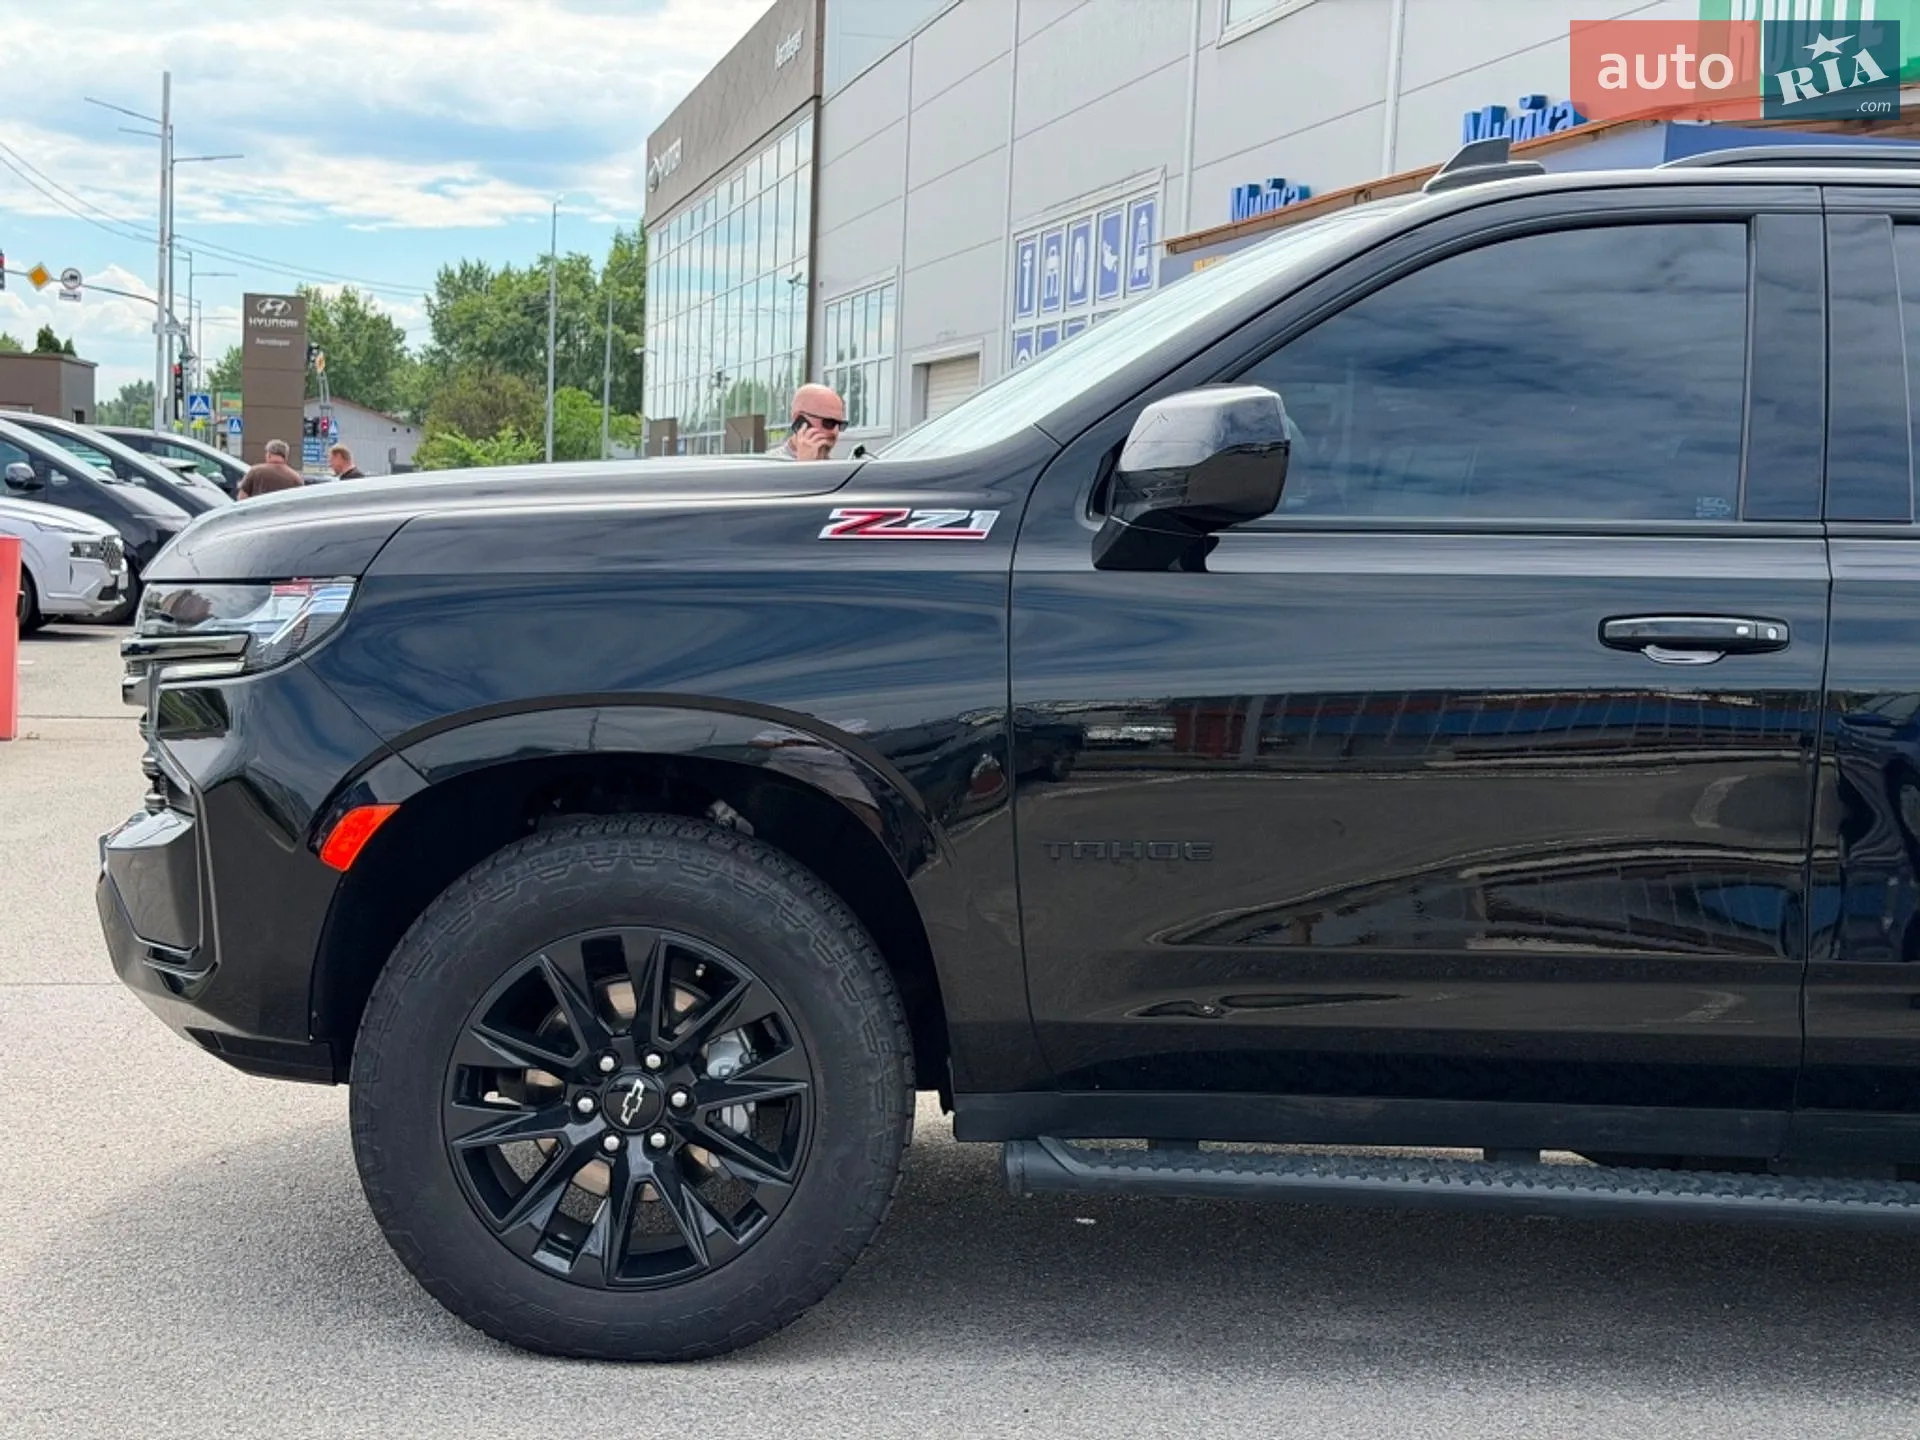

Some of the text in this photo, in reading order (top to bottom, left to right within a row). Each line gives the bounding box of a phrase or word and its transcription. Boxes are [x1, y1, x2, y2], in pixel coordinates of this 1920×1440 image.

[248, 316, 299, 328] HYUNDAI
[818, 508, 1000, 540] Z71
[1041, 840, 1215, 861] TAHOE
